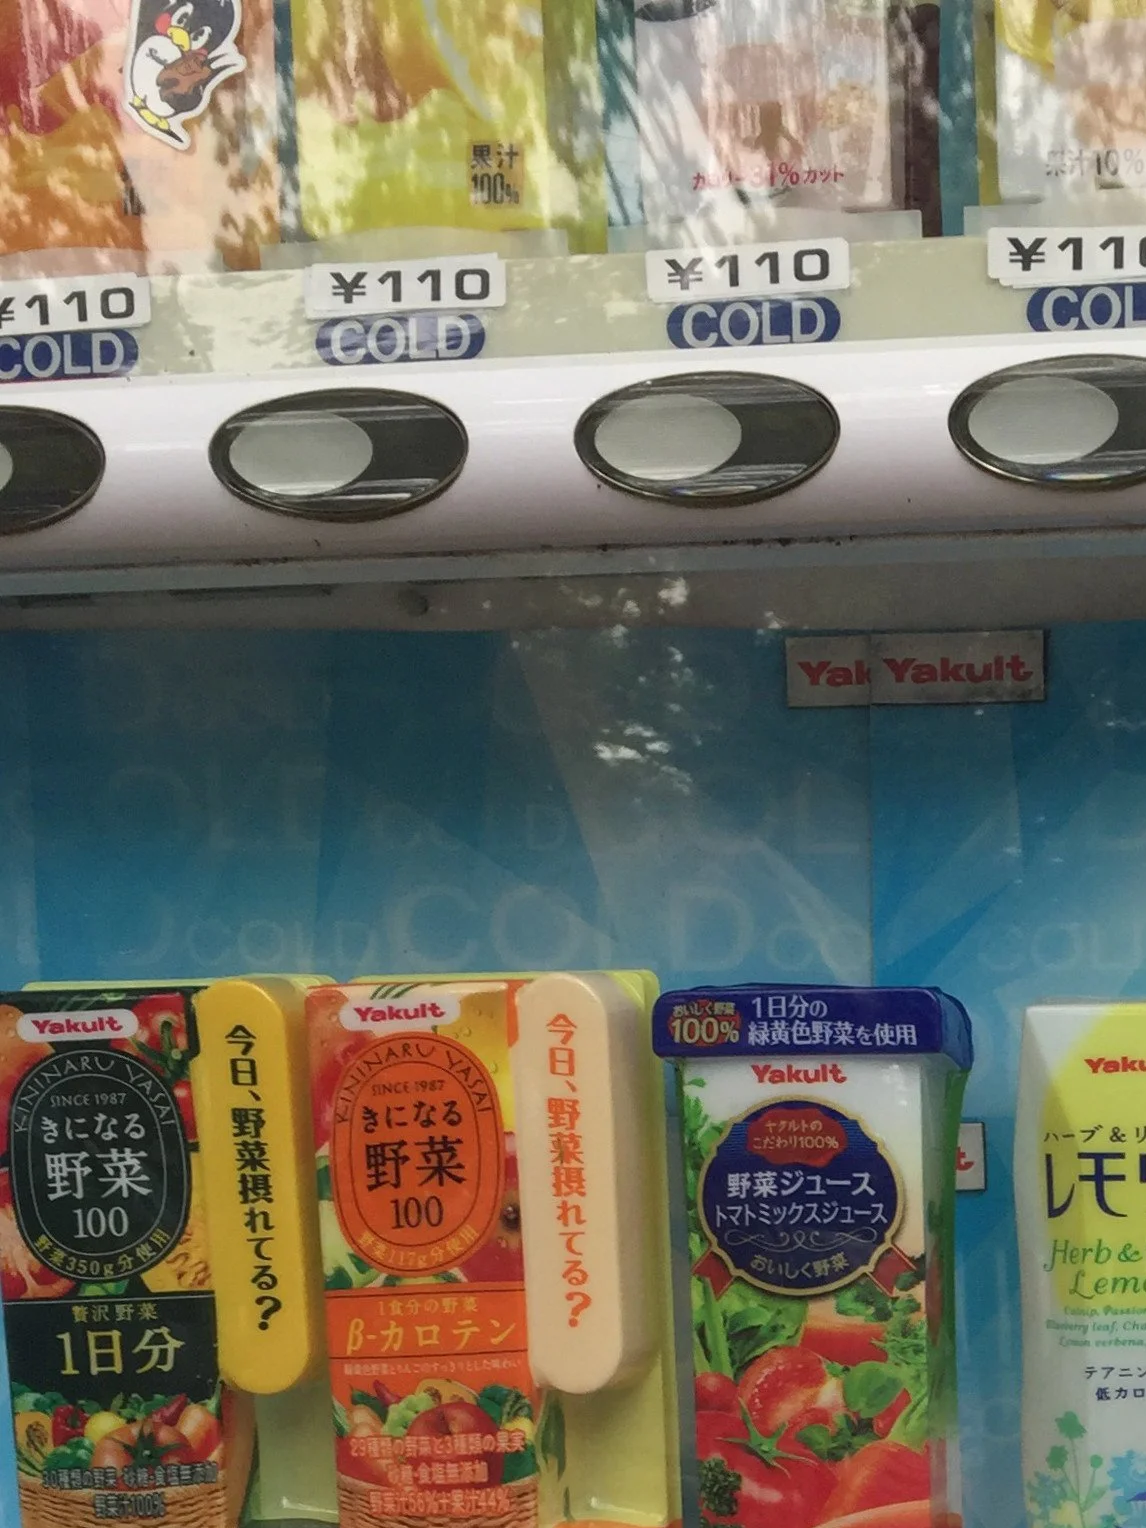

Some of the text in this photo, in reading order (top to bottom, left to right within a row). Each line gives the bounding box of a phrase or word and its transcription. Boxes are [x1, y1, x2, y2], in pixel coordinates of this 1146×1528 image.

[470, 144, 521, 170] 果汁
[470, 171, 521, 205] 100%
[666, 248, 831, 290] ¥110
[331, 269, 491, 303] ¥110
[682, 300, 826, 347] COLD
[329, 314, 472, 364] COLD
[882, 654, 1033, 684] Yakult
[354, 1000, 447, 1023] Yakult
[751, 995, 828, 1019] 1日分の
[31, 1016, 123, 1034] Yakult
[671, 1018, 741, 1045] 100%
[747, 1021, 918, 1047] 緑黄色野菜を使用
[445, 1050, 492, 1114] YASAI
[750, 1064, 848, 1085] Yakult
[13, 1055, 176, 1133] KININARU YASAI
[50, 1093, 127, 1107] SINCE 1987
[40, 1112, 146, 1142] きになる
[362, 1099, 463, 1133] きになる
[765, 1119, 823, 1133] ヤクルトの
[752, 1134, 840, 1150] こだわり100%
[45, 1146, 153, 1201] 野菜
[225, 1024, 283, 1332] 今日、野菜摂れてる？
[365, 1135, 467, 1192] 野菜
[546, 1012, 592, 1328] 今日、野菜摂れてる？
[727, 1170, 877, 1199] 野菜ジュース
[73, 1207, 129, 1238] 100
[391, 1196, 444, 1230] 100
[715, 1201, 889, 1228] トマトミックスジュース
[750, 1252, 850, 1279] おいしく野菜
[1043, 1238, 1112, 1272] Herb
[1117, 1242, 1143, 1263] &
[72, 1303, 158, 1323] 贅沢野菜
[55, 1326, 186, 1376] 1日分
